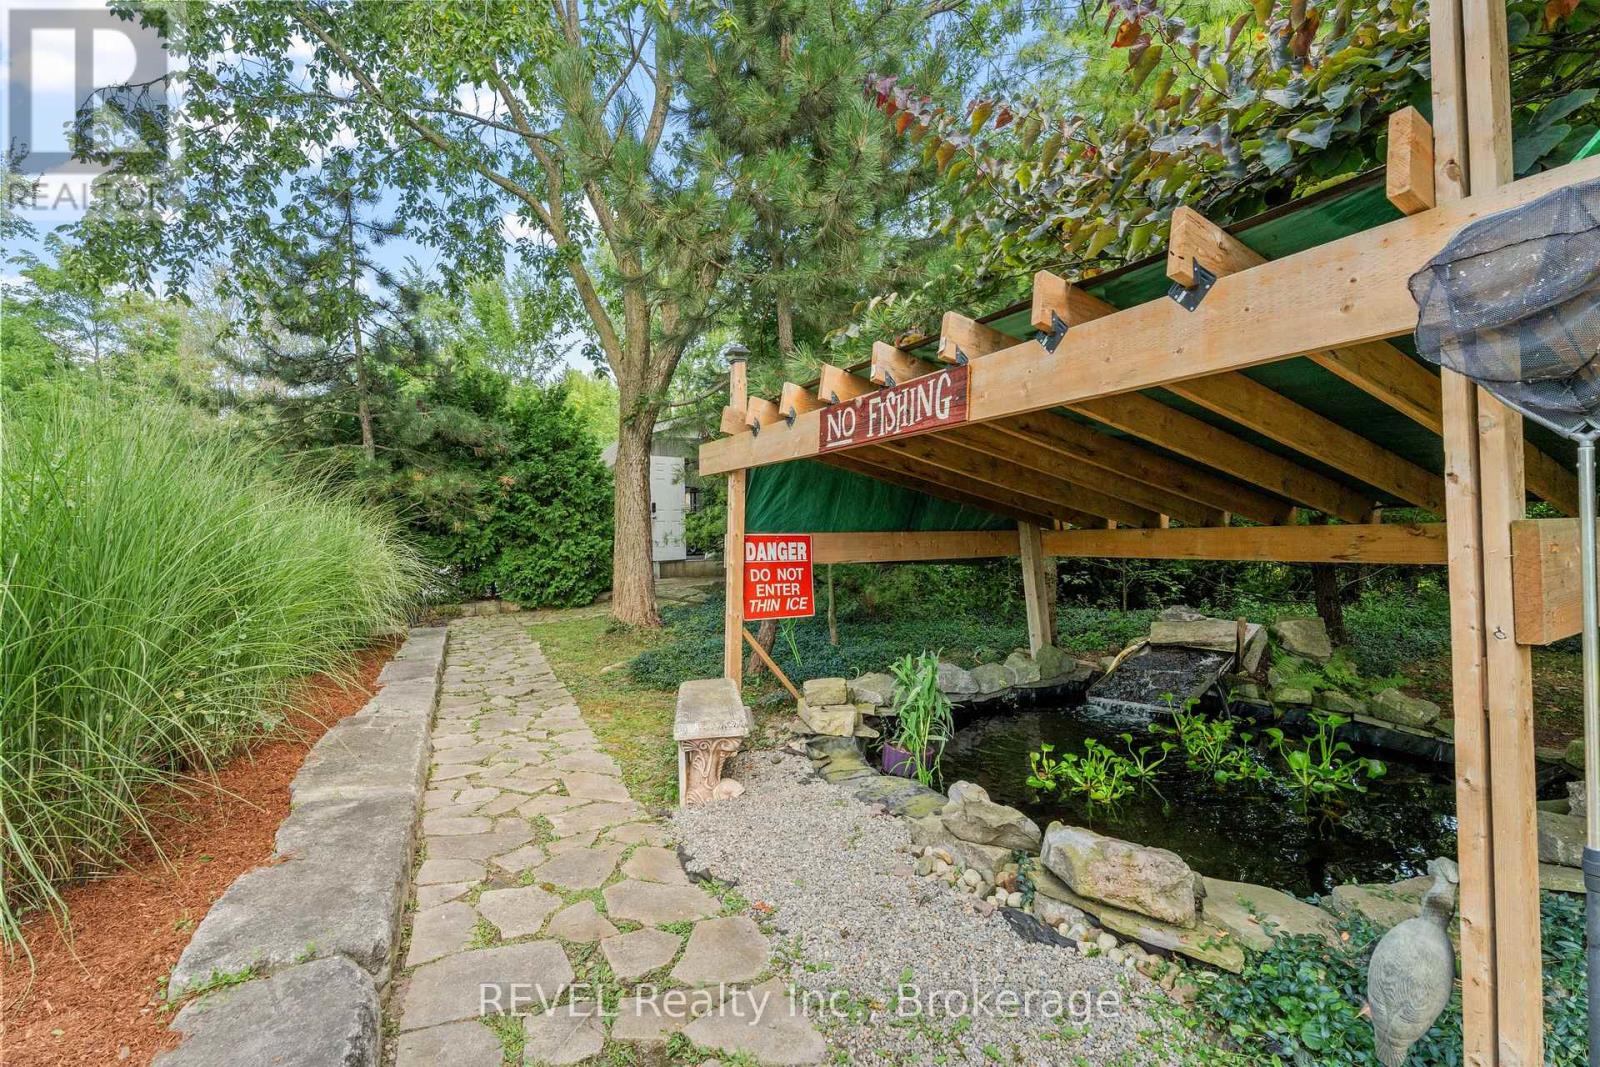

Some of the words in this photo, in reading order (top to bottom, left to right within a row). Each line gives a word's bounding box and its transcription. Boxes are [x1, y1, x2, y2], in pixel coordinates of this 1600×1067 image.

[826, 407, 857, 440] NO
[867, 371, 953, 437] FISHING
[745, 542, 807, 561] DANGER
[750, 568, 771, 582] DO
[777, 568, 804, 581] NOT
[756, 583, 801, 597] ENTER
[749, 598, 781, 612] THIN
[786, 597, 808, 611] ICE
